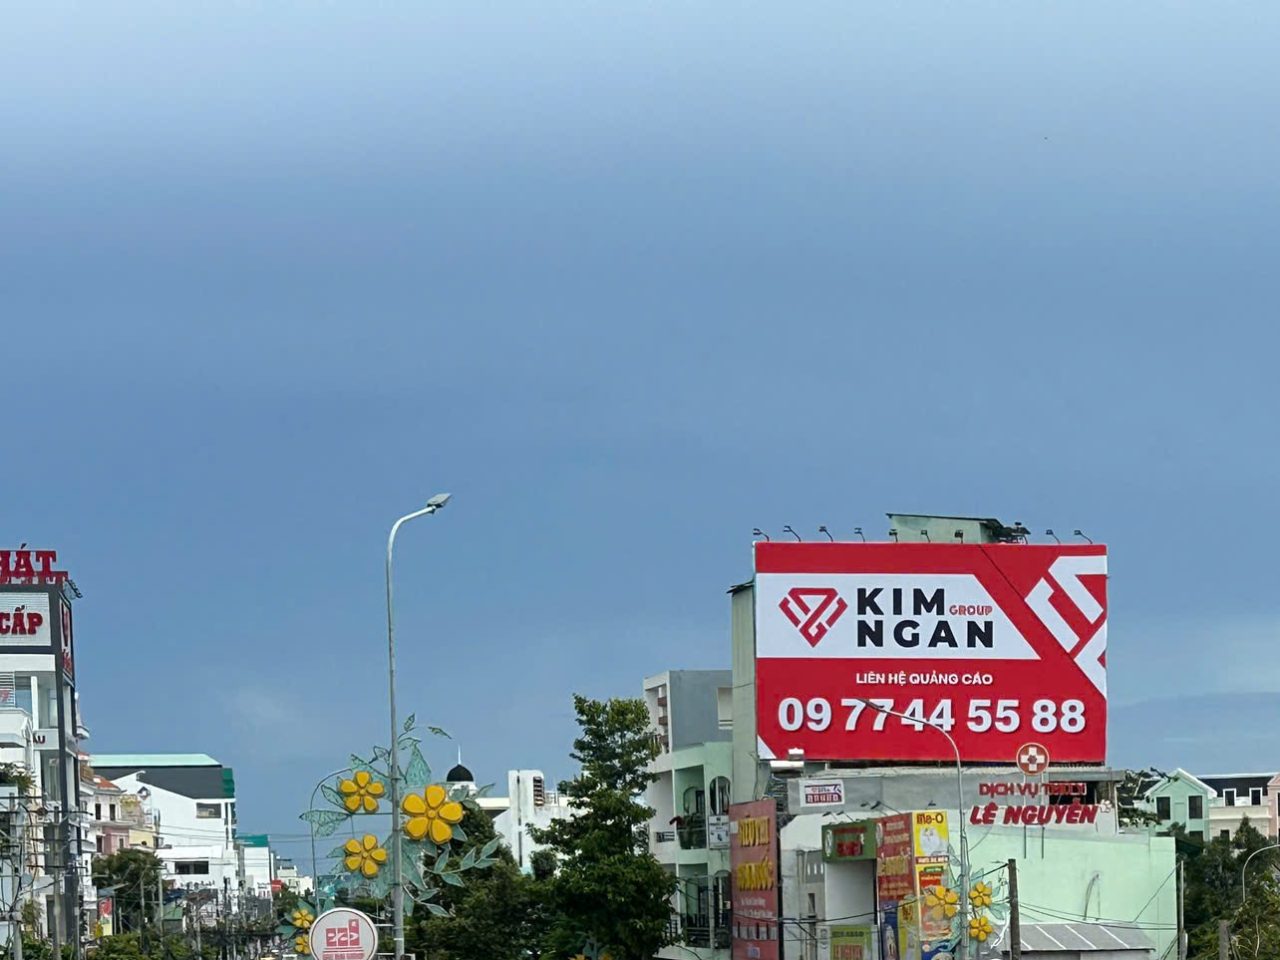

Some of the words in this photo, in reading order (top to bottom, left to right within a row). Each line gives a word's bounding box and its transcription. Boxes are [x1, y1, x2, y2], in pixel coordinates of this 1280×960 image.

[857, 588, 945, 616] KIM
[949, 604, 993, 616] GROUP
[857, 620, 993, 648] NGAN
[856, 671, 885, 684] LIÊN
[888, 670, 906, 687] HỆ
[909, 669, 959, 685] QUẢNG
[962, 671, 993, 685] CÁO
[778, 697, 832, 732] 09
[841, 698, 894, 731] 77
[901, 698, 955, 732] 44
[967, 699, 1020, 733] 55
[1031, 699, 1086, 733] 88
[979, 783, 1014, 798] DỊCH
[1018, 784, 1038, 798] VỤ
[970, 802, 999, 825] LÊ
